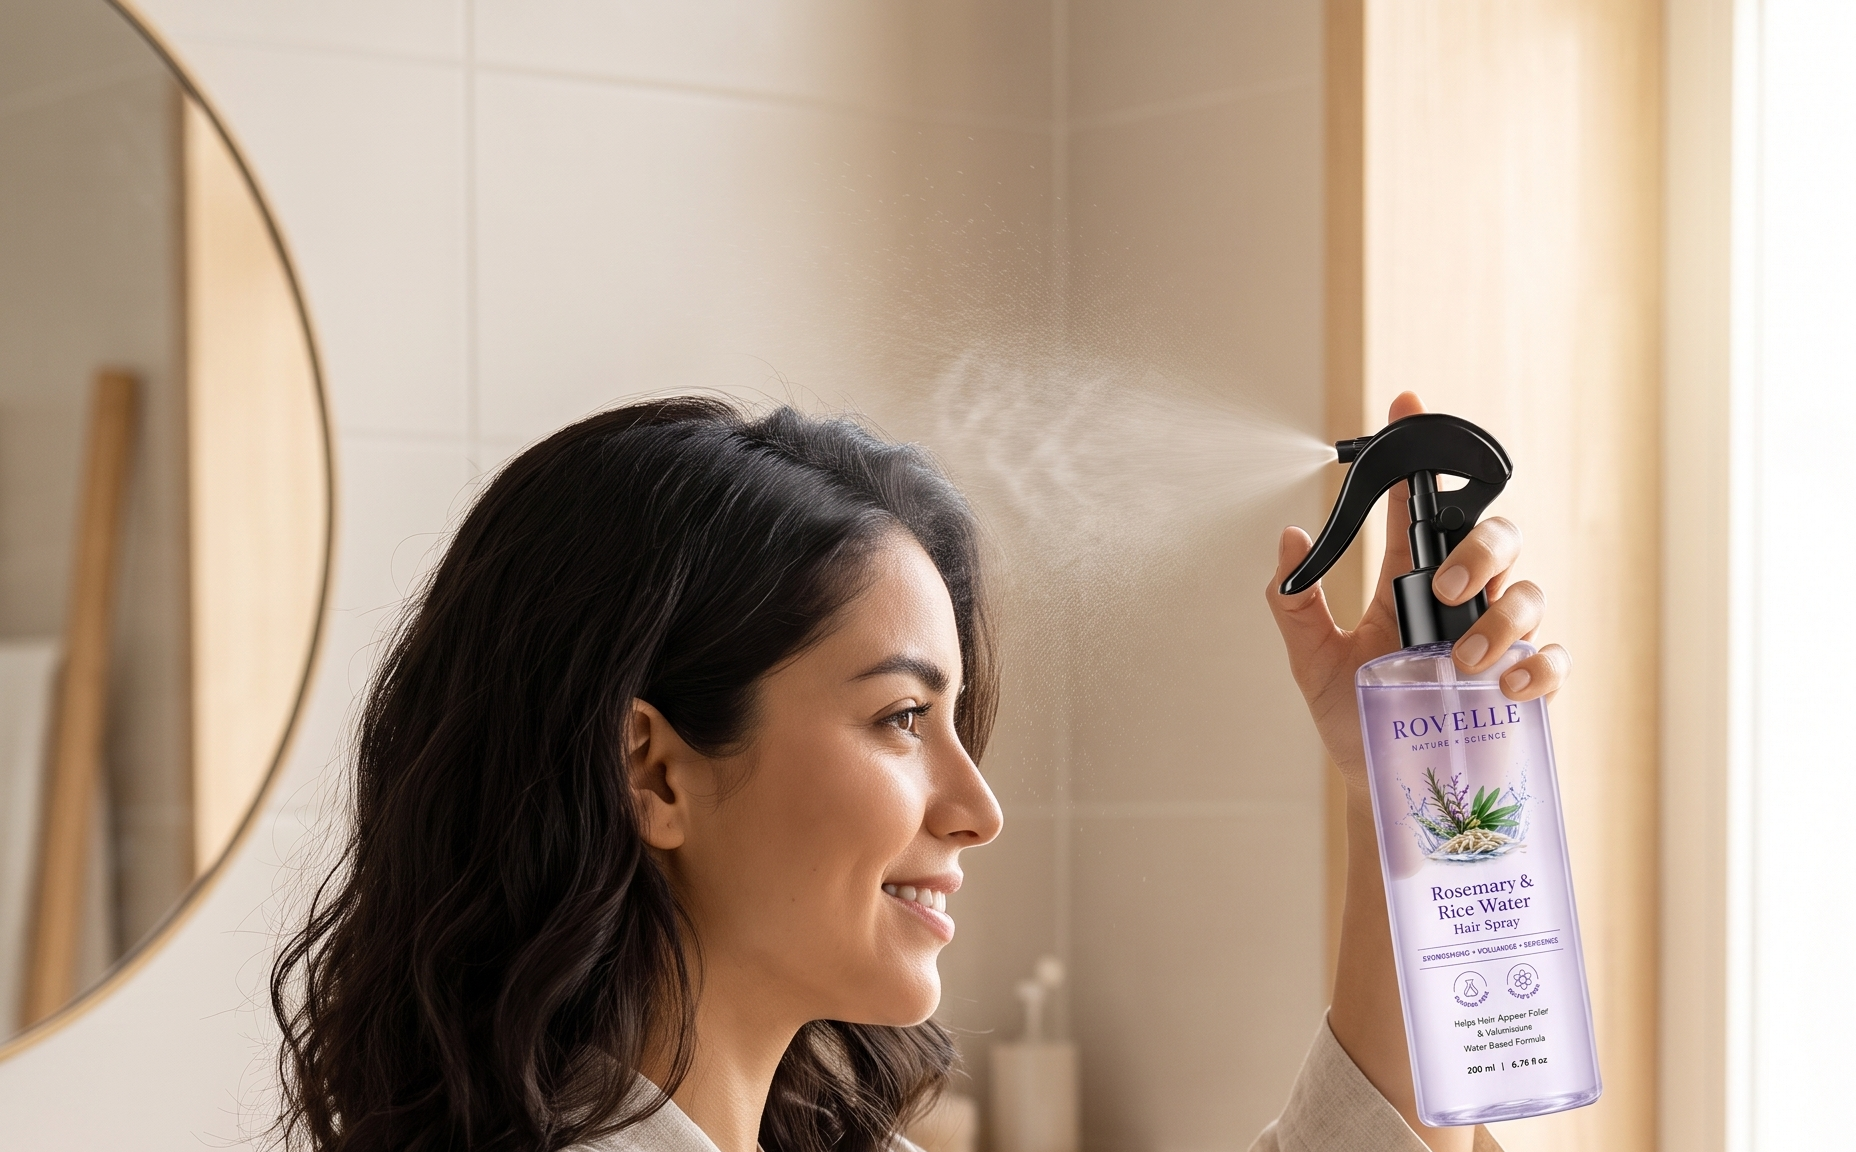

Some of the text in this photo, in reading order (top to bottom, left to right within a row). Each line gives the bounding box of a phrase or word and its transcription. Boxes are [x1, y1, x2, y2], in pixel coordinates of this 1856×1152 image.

[1392, 703, 1521, 740] ROVELLE
[1412, 739, 1450, 752] NATURE
[1464, 731, 1507, 744] SCIENCE
[1431, 873, 1534, 901] Rosemary &
[1438, 896, 1531, 920] Rice Water
[1453, 917, 1521, 935] Hair Spray
[1454, 1018, 1476, 1028] Helps
[1477, 1029, 1484, 1038] &
[1463, 1034, 1546, 1053] Water Based Formula
[1467, 1065, 1483, 1075] 200
[1485, 1063, 1496, 1073] ml
[1511, 1059, 1530, 1069] 6.76
[1531, 1057, 1537, 1066] fl
[1538, 1057, 1548, 1065] oz
